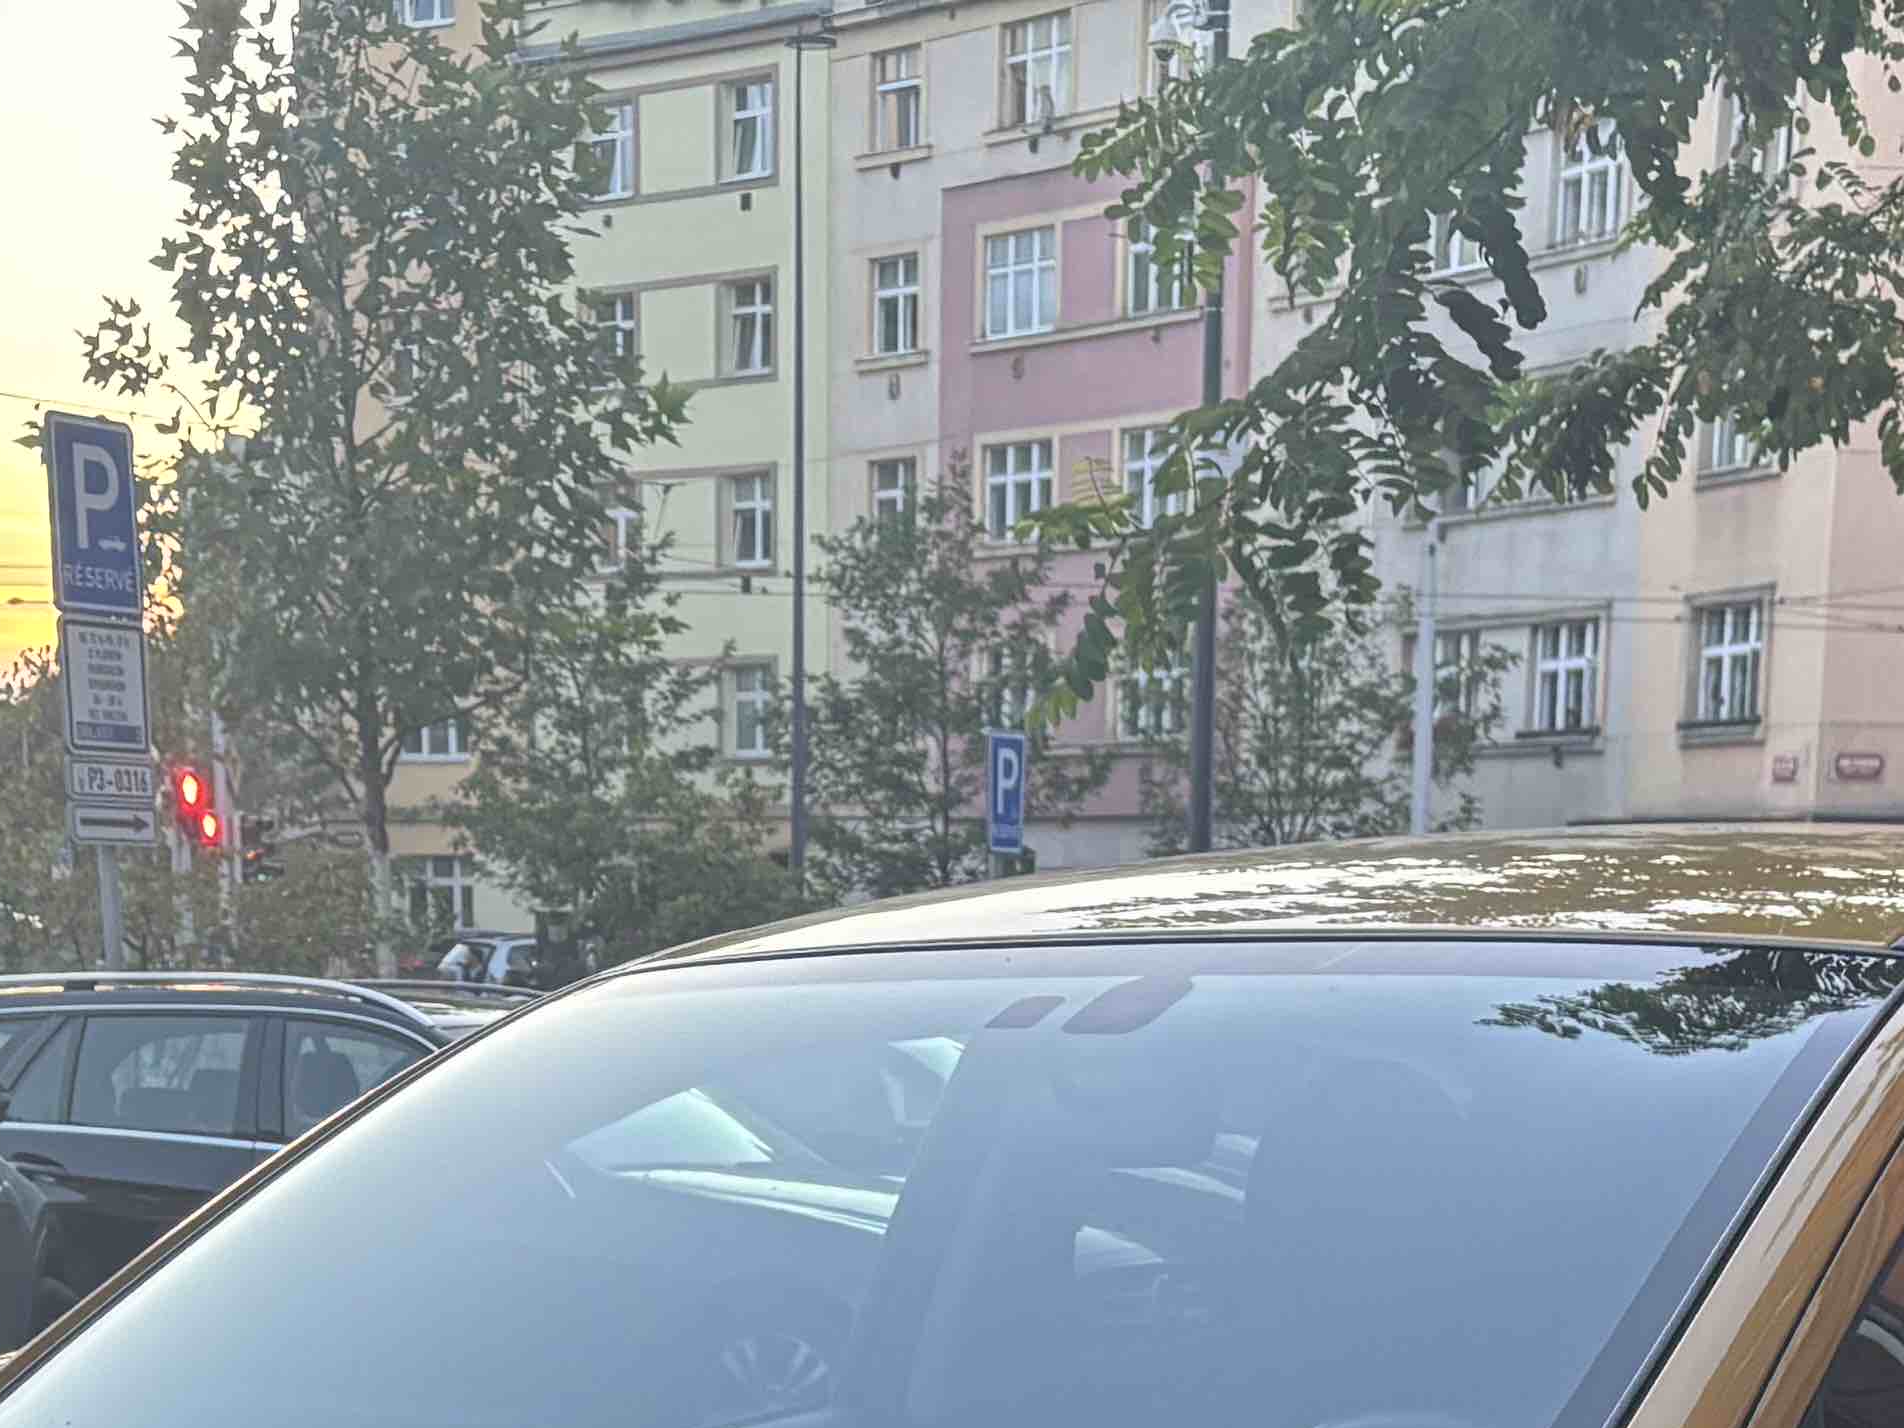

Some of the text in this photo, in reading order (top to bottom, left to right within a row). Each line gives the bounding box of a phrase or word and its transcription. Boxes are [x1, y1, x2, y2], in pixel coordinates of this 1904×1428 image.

[72, 441, 119, 549] P
[63, 561, 135, 592] RÉSERVÉ
[997, 747, 1019, 815] P
